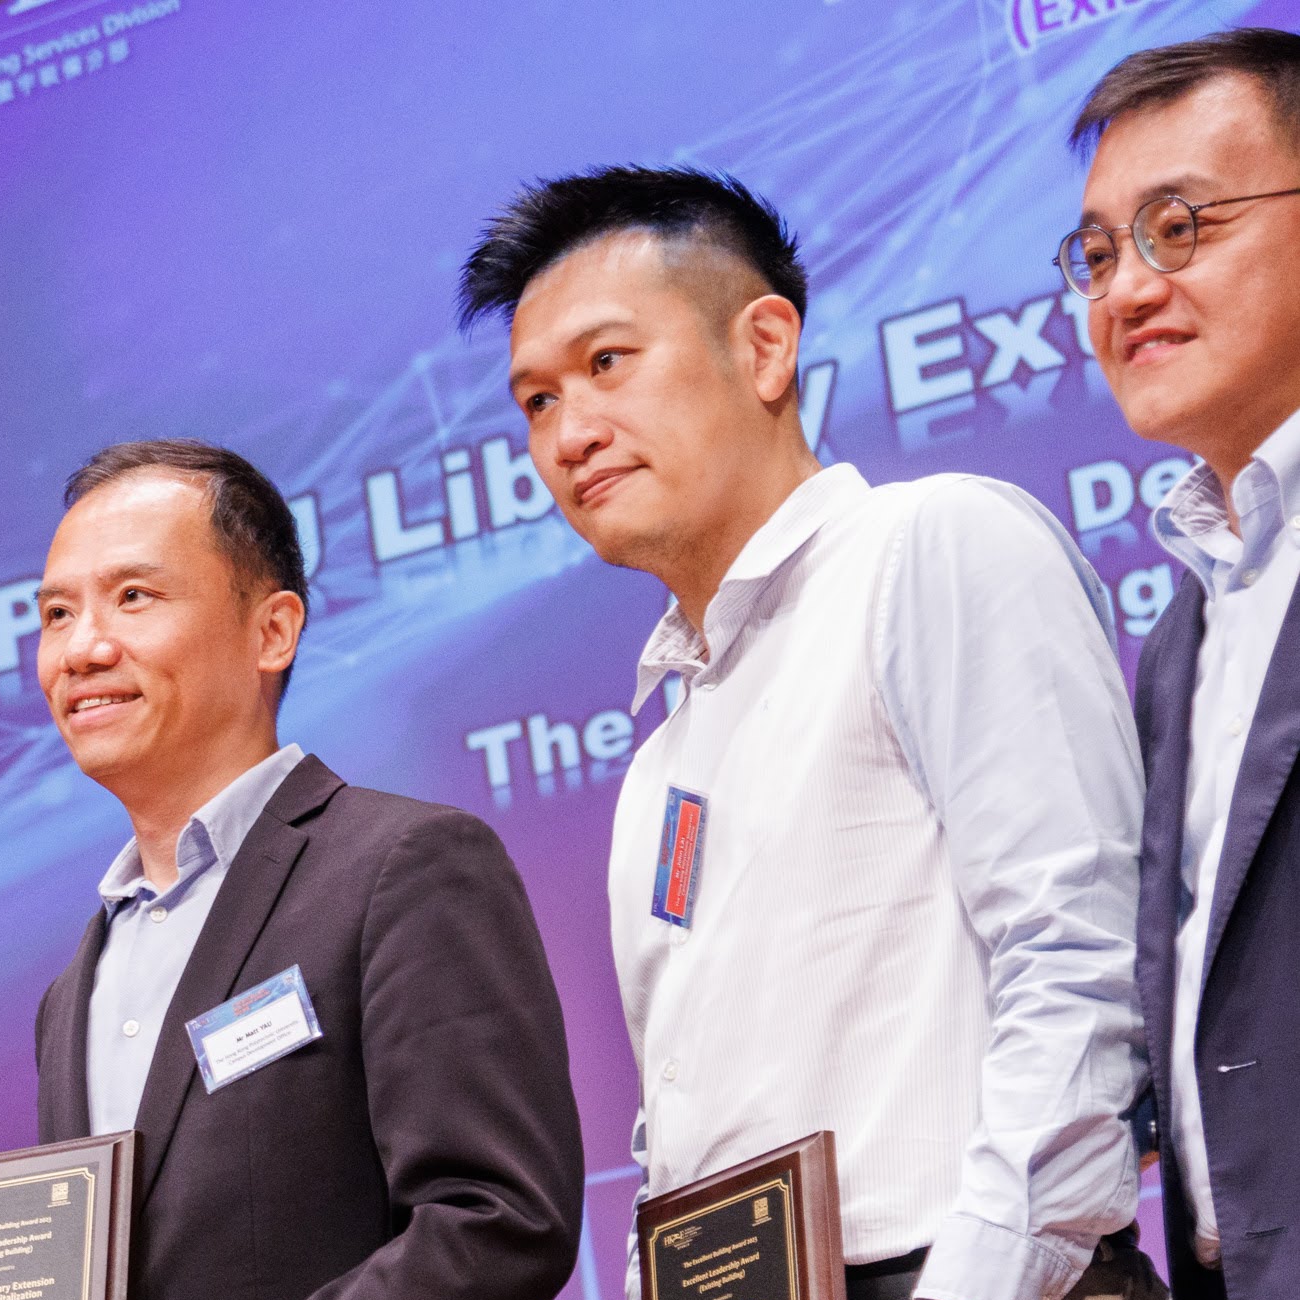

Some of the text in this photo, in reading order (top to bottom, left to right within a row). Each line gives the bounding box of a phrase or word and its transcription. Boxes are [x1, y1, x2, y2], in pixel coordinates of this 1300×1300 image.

[23, 26, 101, 65] Services
[102, 0, 181, 37] Division
[465, 709, 635, 786] The
[236, 1036, 245, 1044] Mr
[245, 1027, 259, 1039] Matt
[29, 1230, 52, 1242] Award
[5, 1244, 34, 1256] Building)
[682, 1251, 760, 1288] Excellent Leadership Award
[12, 1276, 55, 1291] Extension
[699, 1268, 746, 1295] (Existing Building)
